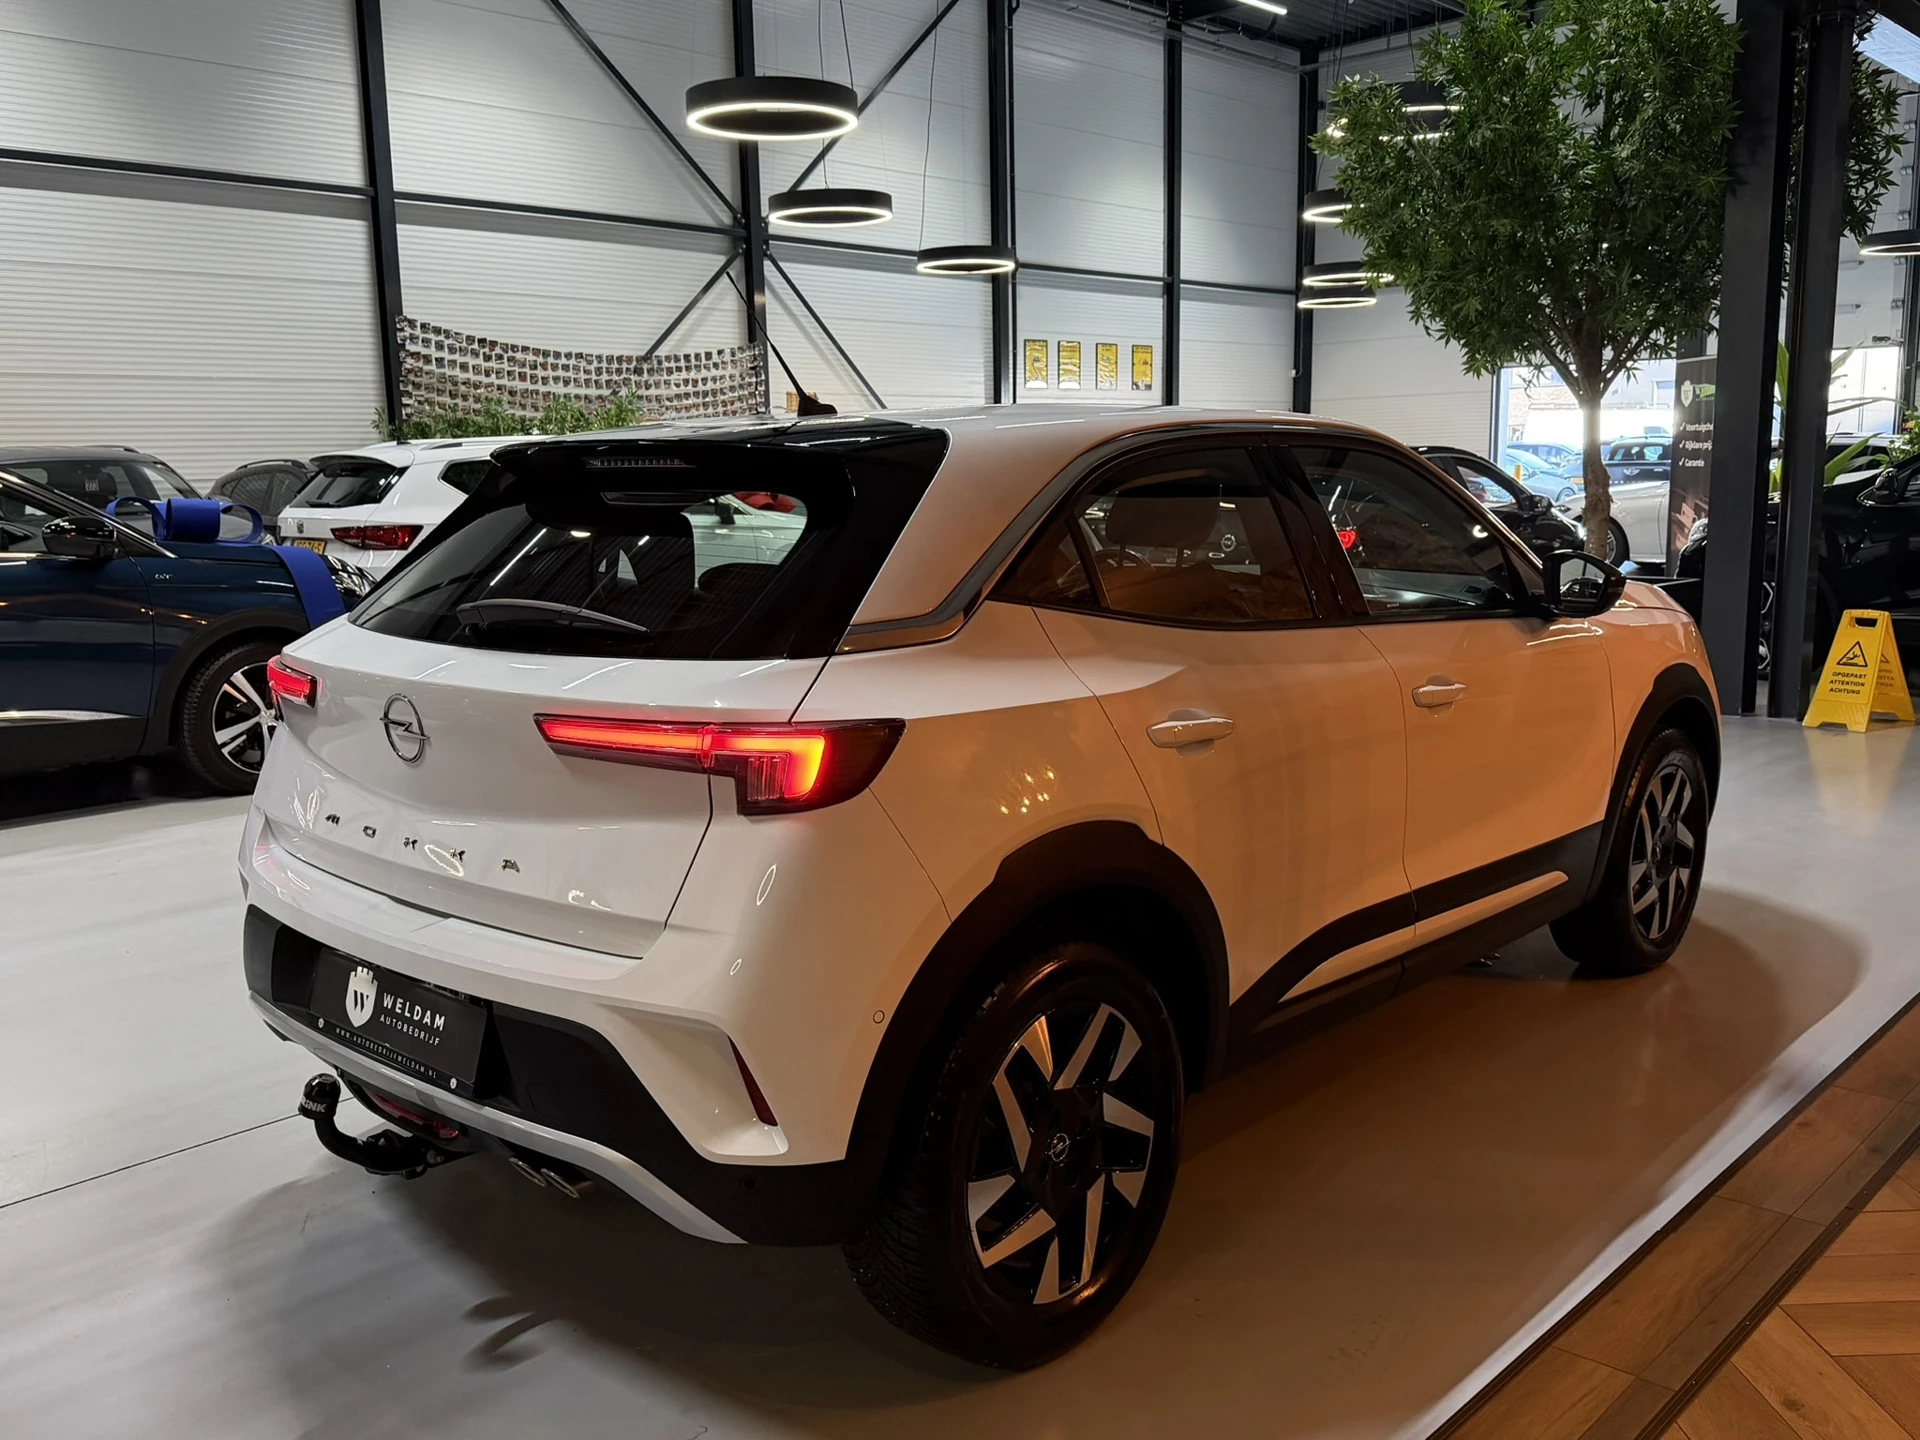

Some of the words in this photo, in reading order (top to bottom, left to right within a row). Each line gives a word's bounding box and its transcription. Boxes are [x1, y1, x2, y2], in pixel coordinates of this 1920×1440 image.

[1832, 671, 1867, 680] OPGEPAST
[1829, 679, 1865, 688] ATTENTION
[1829, 687, 1860, 695] ACHTUNG
[383, 992, 445, 1031] WELDAM
[379, 1014, 440, 1046] AUTOBEDRIJF
